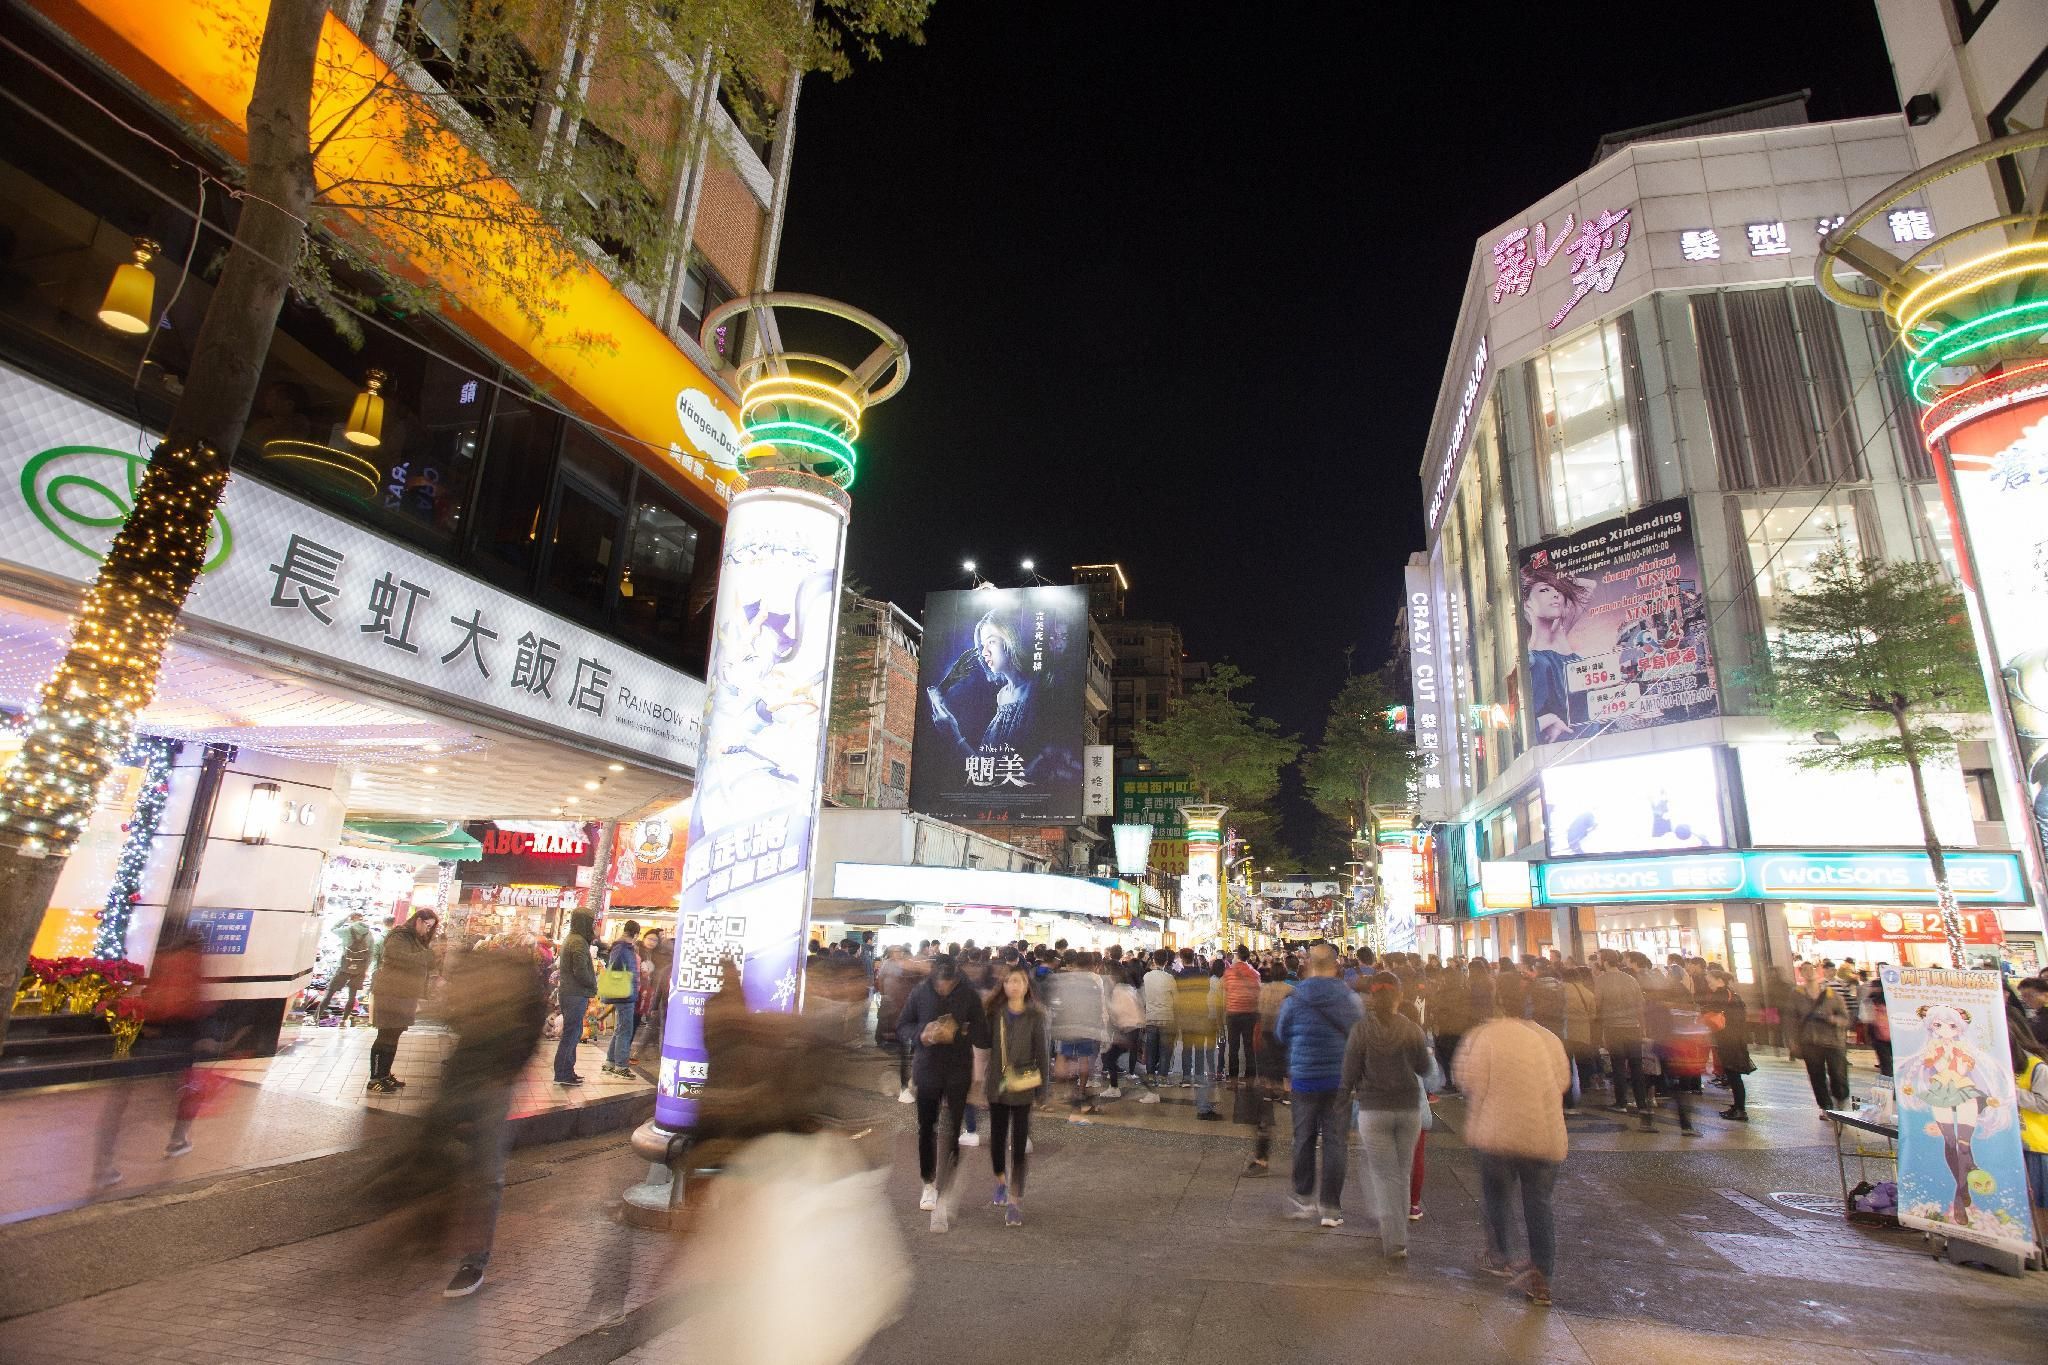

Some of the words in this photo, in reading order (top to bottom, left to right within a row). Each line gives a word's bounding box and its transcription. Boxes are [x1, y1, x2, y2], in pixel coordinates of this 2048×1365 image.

[1681, 208, 1935, 261] 髮型龍
[1464, 335, 1487, 417] SALON
[1550, 535, 1607, 560] Welcome
[1609, 510, 1682, 542] Ximending
[1623, 534, 1656, 550] Beautiful
[1656, 524, 1683, 539] stylish
[268, 533, 613, 718] 長虹大飯店
[1412, 592, 1432, 655] CRAZY
[1417, 664, 1436, 703] CUT
[1584, 670, 1608, 686] 350
[482, 829, 585, 854] ABC-MART
[1558, 870, 1660, 890] watsons
[1778, 864, 1910, 885] watsons
